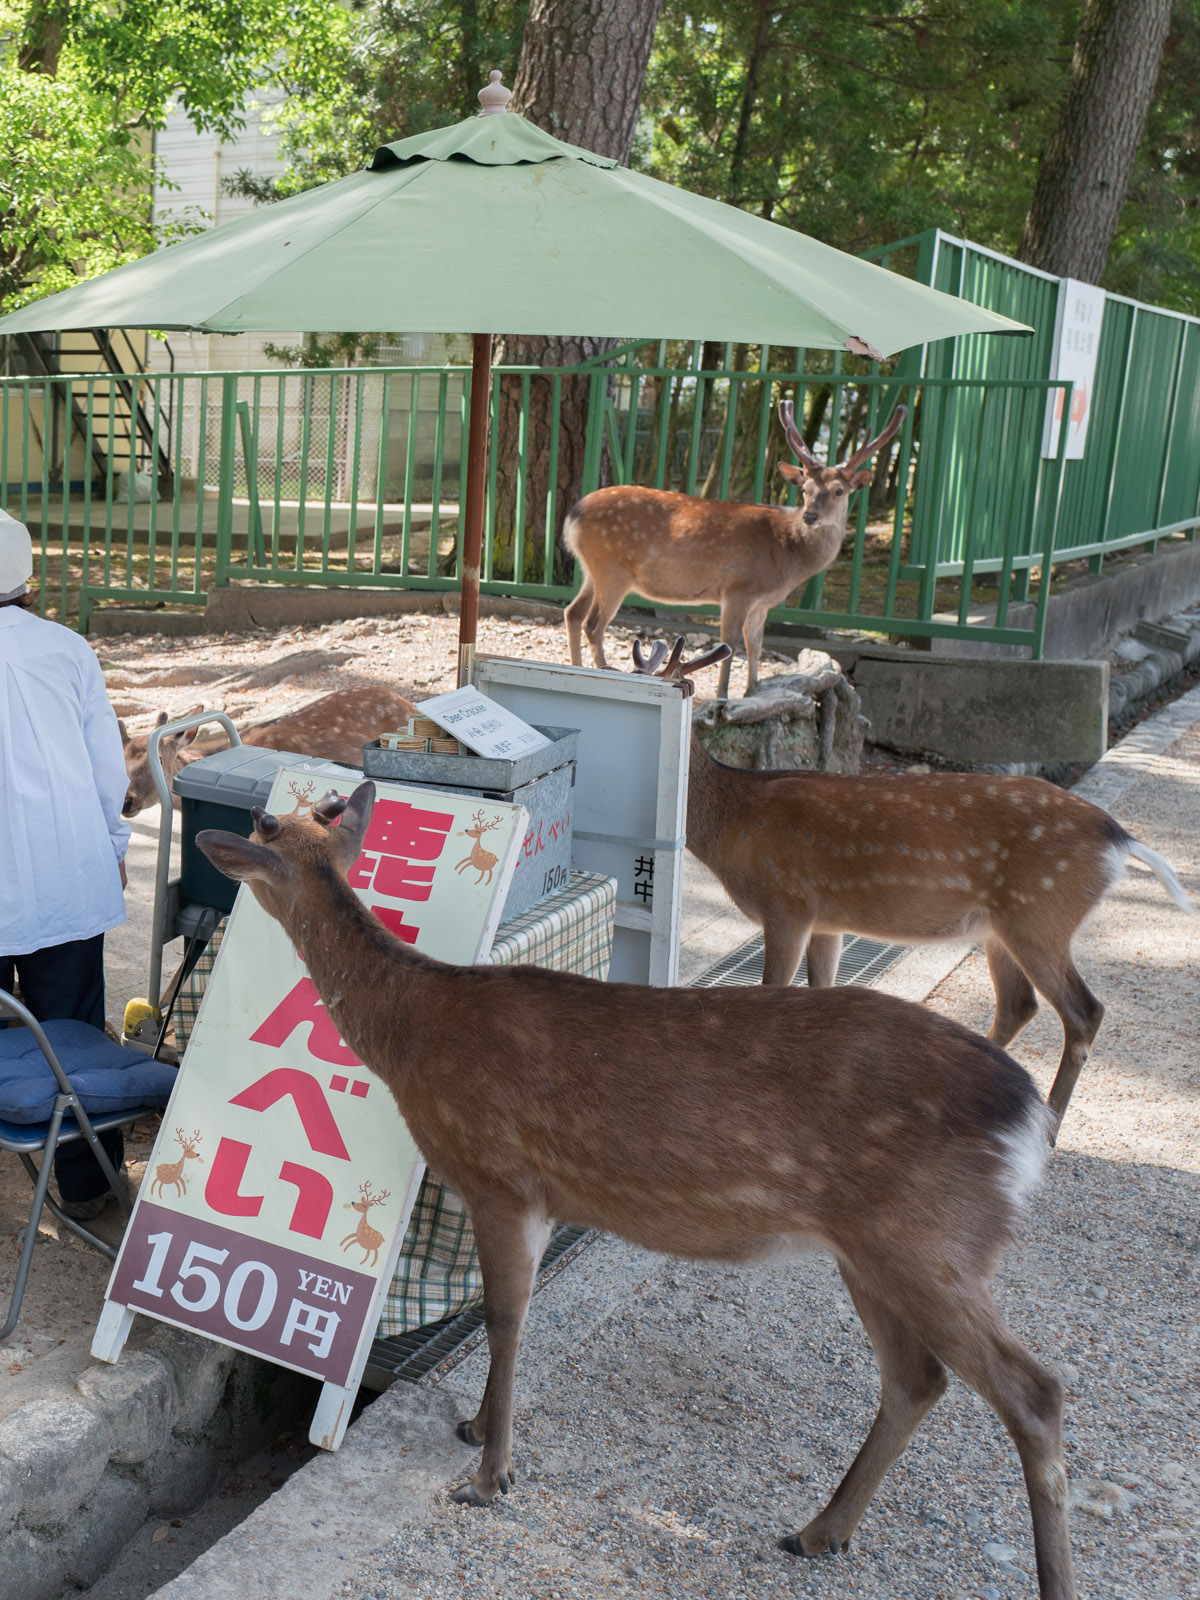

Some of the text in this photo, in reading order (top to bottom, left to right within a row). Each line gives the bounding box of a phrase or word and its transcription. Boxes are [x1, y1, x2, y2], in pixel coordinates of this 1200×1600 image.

[443, 704, 488, 723] Deer Cracker
[205, 796, 454, 1240] 鹿んべい
[298, 1269, 354, 1305] YEN
